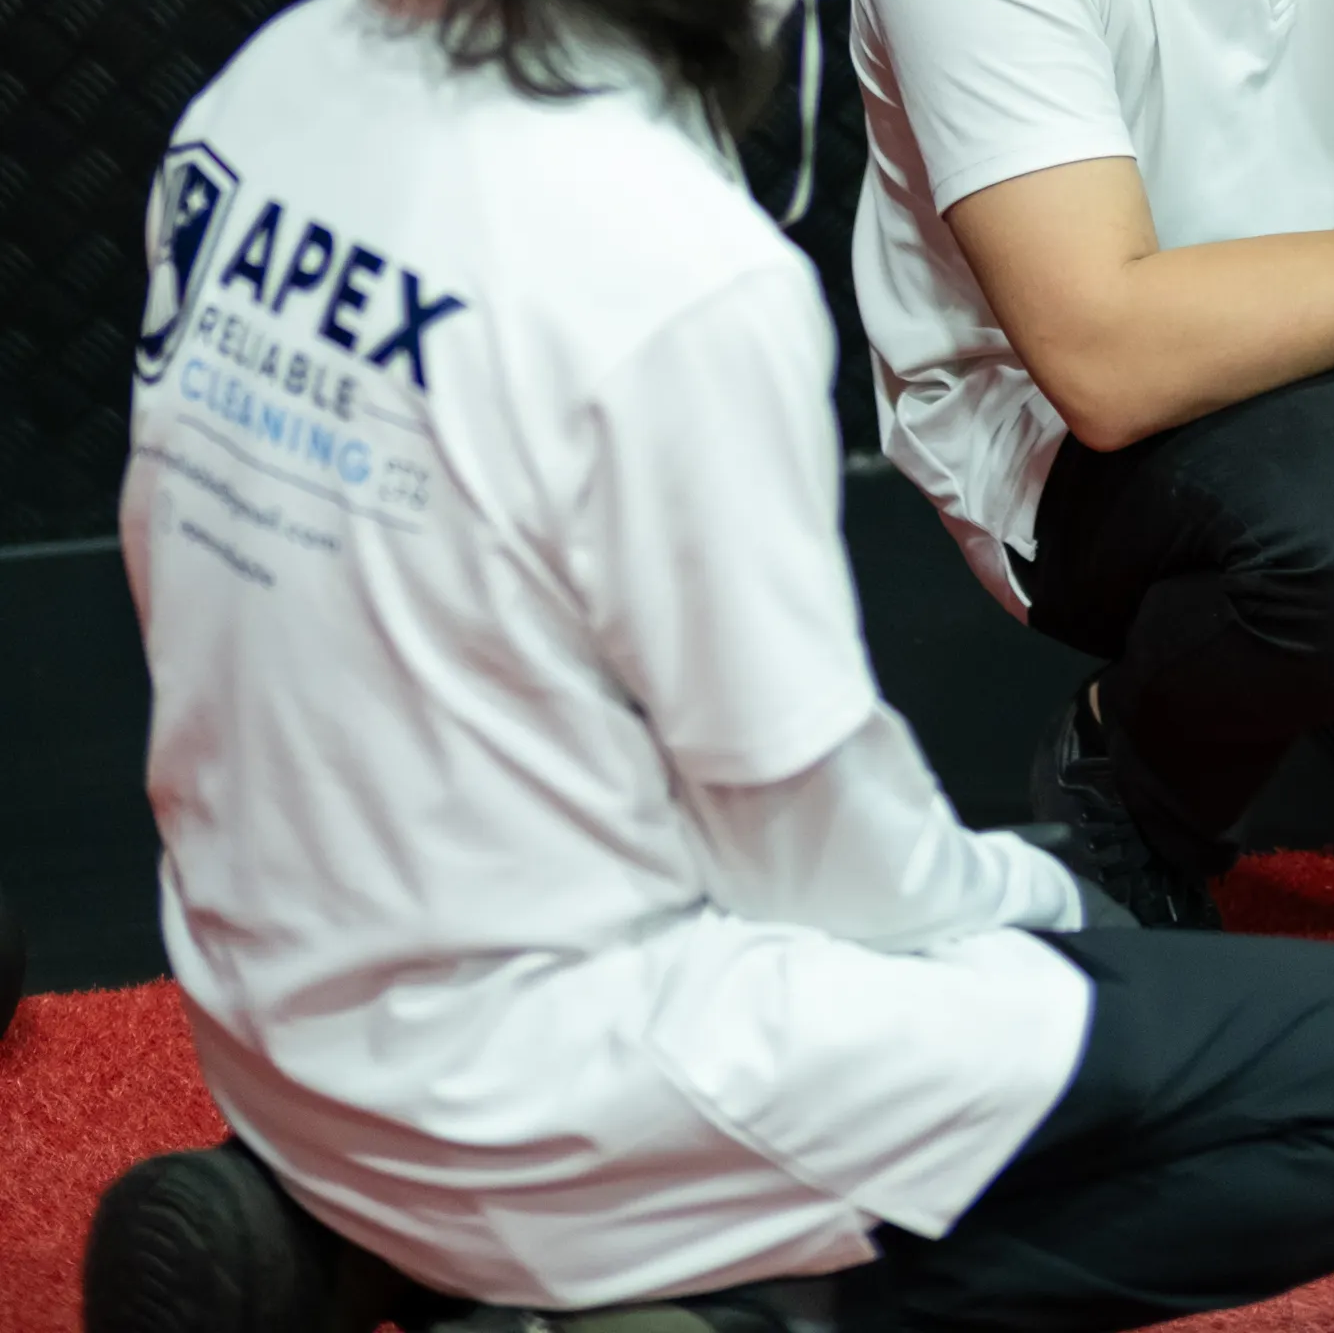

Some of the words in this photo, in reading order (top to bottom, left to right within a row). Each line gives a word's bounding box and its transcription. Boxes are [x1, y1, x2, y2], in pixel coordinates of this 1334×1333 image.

[195, 304, 360, 423] RELIABLE
[218, 199, 468, 397] APEX
[180, 355, 374, 486] CLEANING
